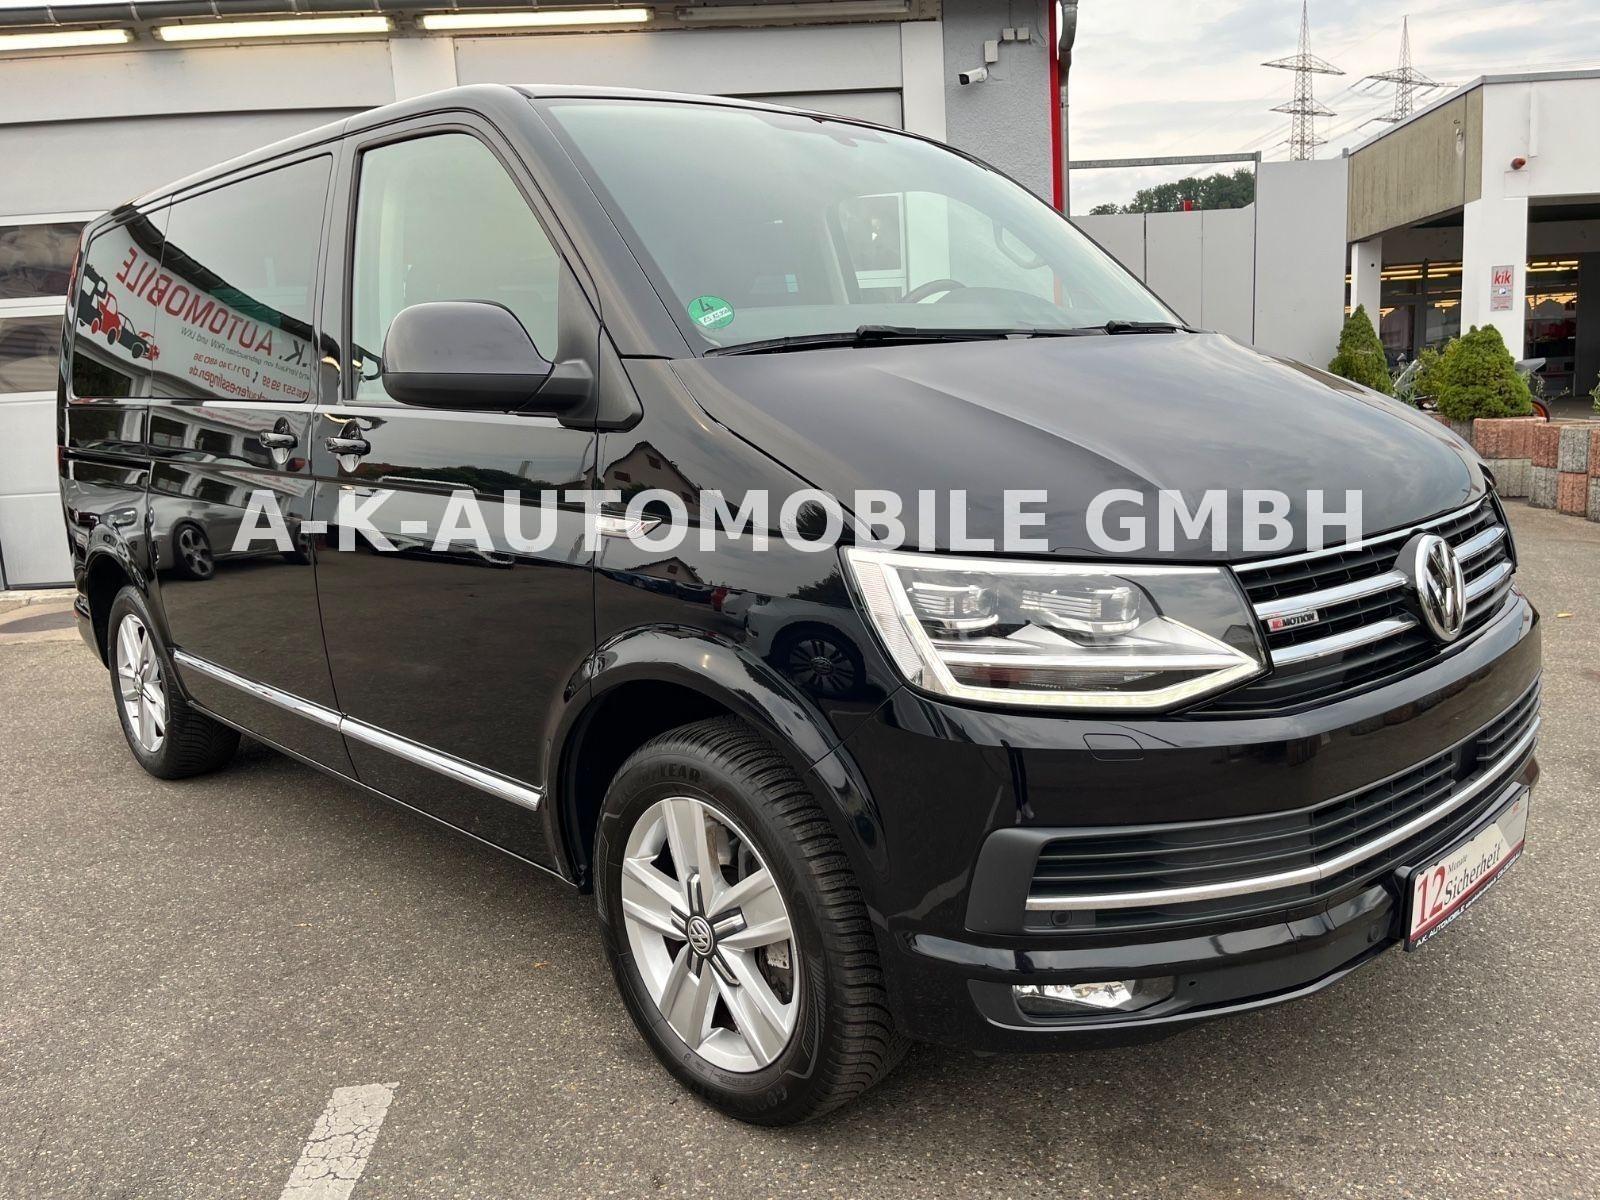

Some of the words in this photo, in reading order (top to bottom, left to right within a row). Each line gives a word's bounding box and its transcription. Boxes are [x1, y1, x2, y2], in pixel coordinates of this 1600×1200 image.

[1494, 270, 1512, 285] kik
[1415, 865, 1446, 928] 12
[1443, 842, 1502, 905] Sicherheit
